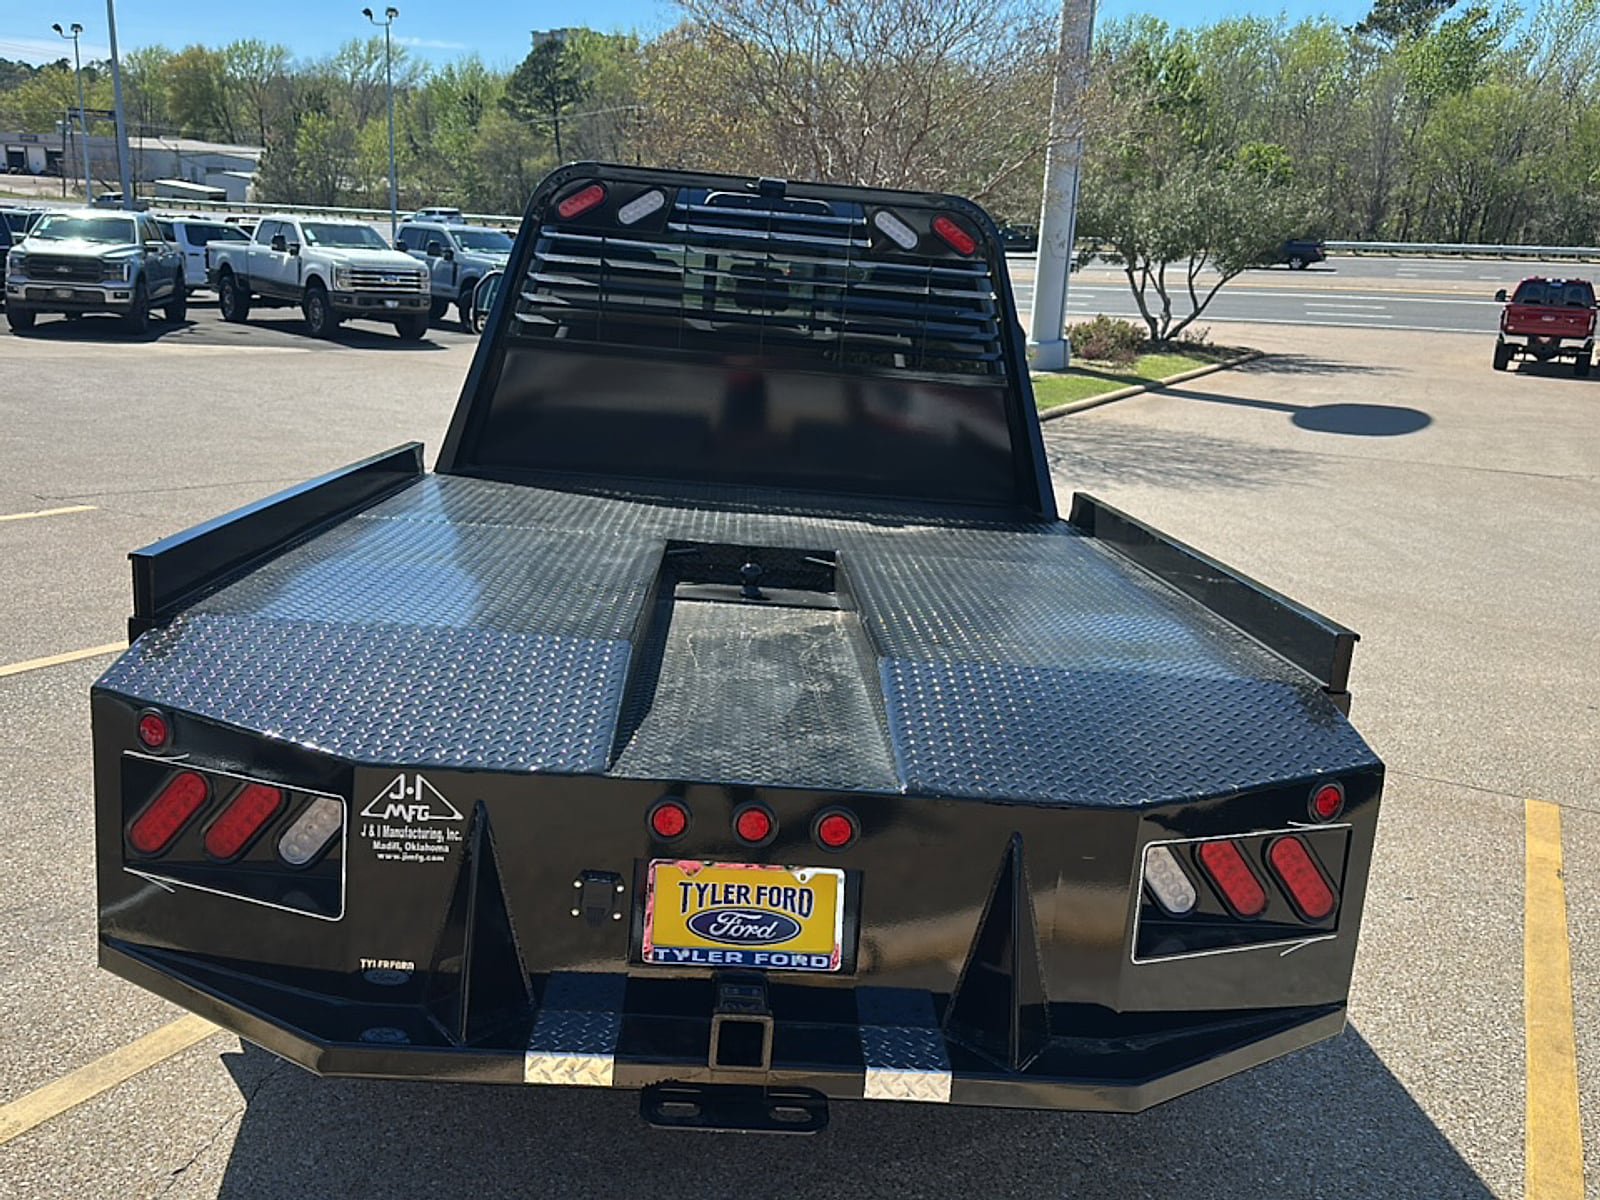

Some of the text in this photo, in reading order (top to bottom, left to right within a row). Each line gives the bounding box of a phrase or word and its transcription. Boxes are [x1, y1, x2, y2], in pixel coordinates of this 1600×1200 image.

[383, 803, 430, 823] MFG
[360, 824, 367, 837] J
[368, 824, 375, 837] &
[405, 842, 449, 853] Oklahoma
[678, 882, 815, 919] TYLER FORD
[709, 911, 777, 939] Ford
[654, 949, 830, 968] TYLER FORD
